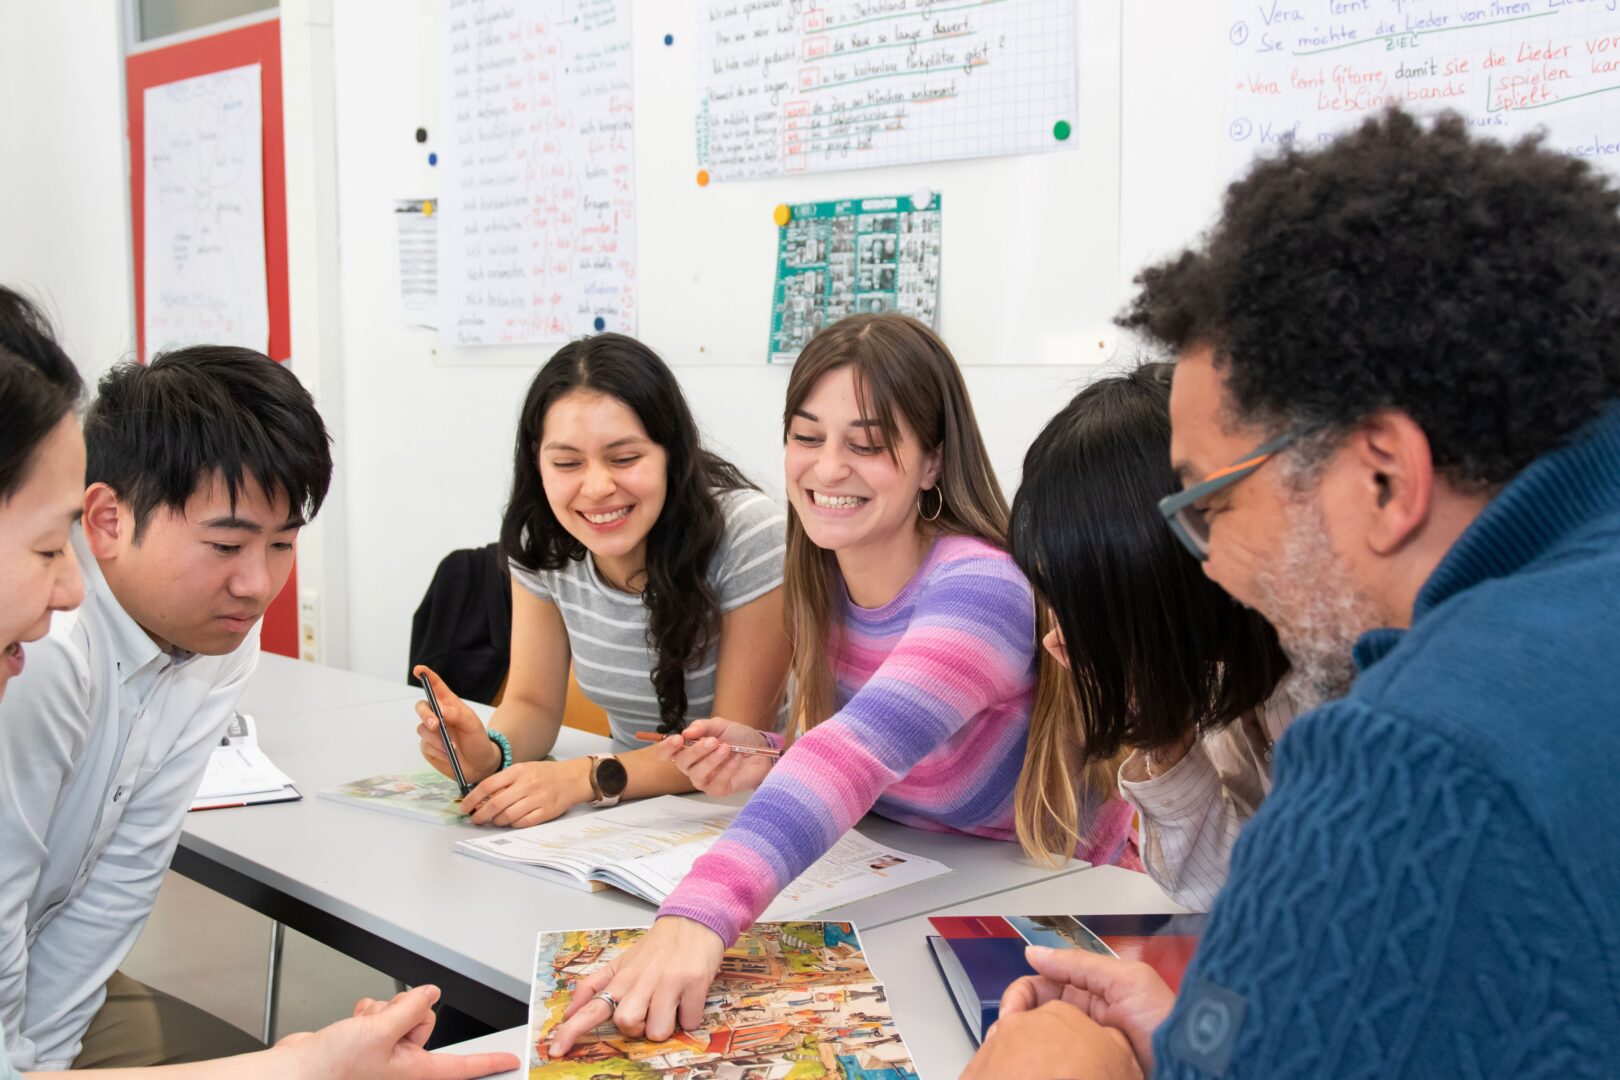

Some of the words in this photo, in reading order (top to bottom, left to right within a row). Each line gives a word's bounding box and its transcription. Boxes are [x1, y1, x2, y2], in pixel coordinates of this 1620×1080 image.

[1257, 32, 1285, 53] Sie
[1298, 25, 1357, 46] möchte
[1375, 18, 1397, 35] die
[1405, 12, 1449, 31] Lieder
[1459, 10, 1486, 22] von
[1489, 1, 1531, 18] ihren
[1259, 0, 1304, 26] Vera
[895, 24, 921, 55] lange
[1384, 35, 1420, 51] ZIEL
[1247, 72, 1281, 95] Vera
[1291, 67, 1325, 90] lernt
[1395, 56, 1438, 79] damit
[1443, 58, 1469, 77] sie
[1482, 47, 1507, 69] die
[1516, 39, 1572, 64] Lieder
[1495, 64, 1572, 96] spielen
[1260, 120, 1301, 145] Kal
